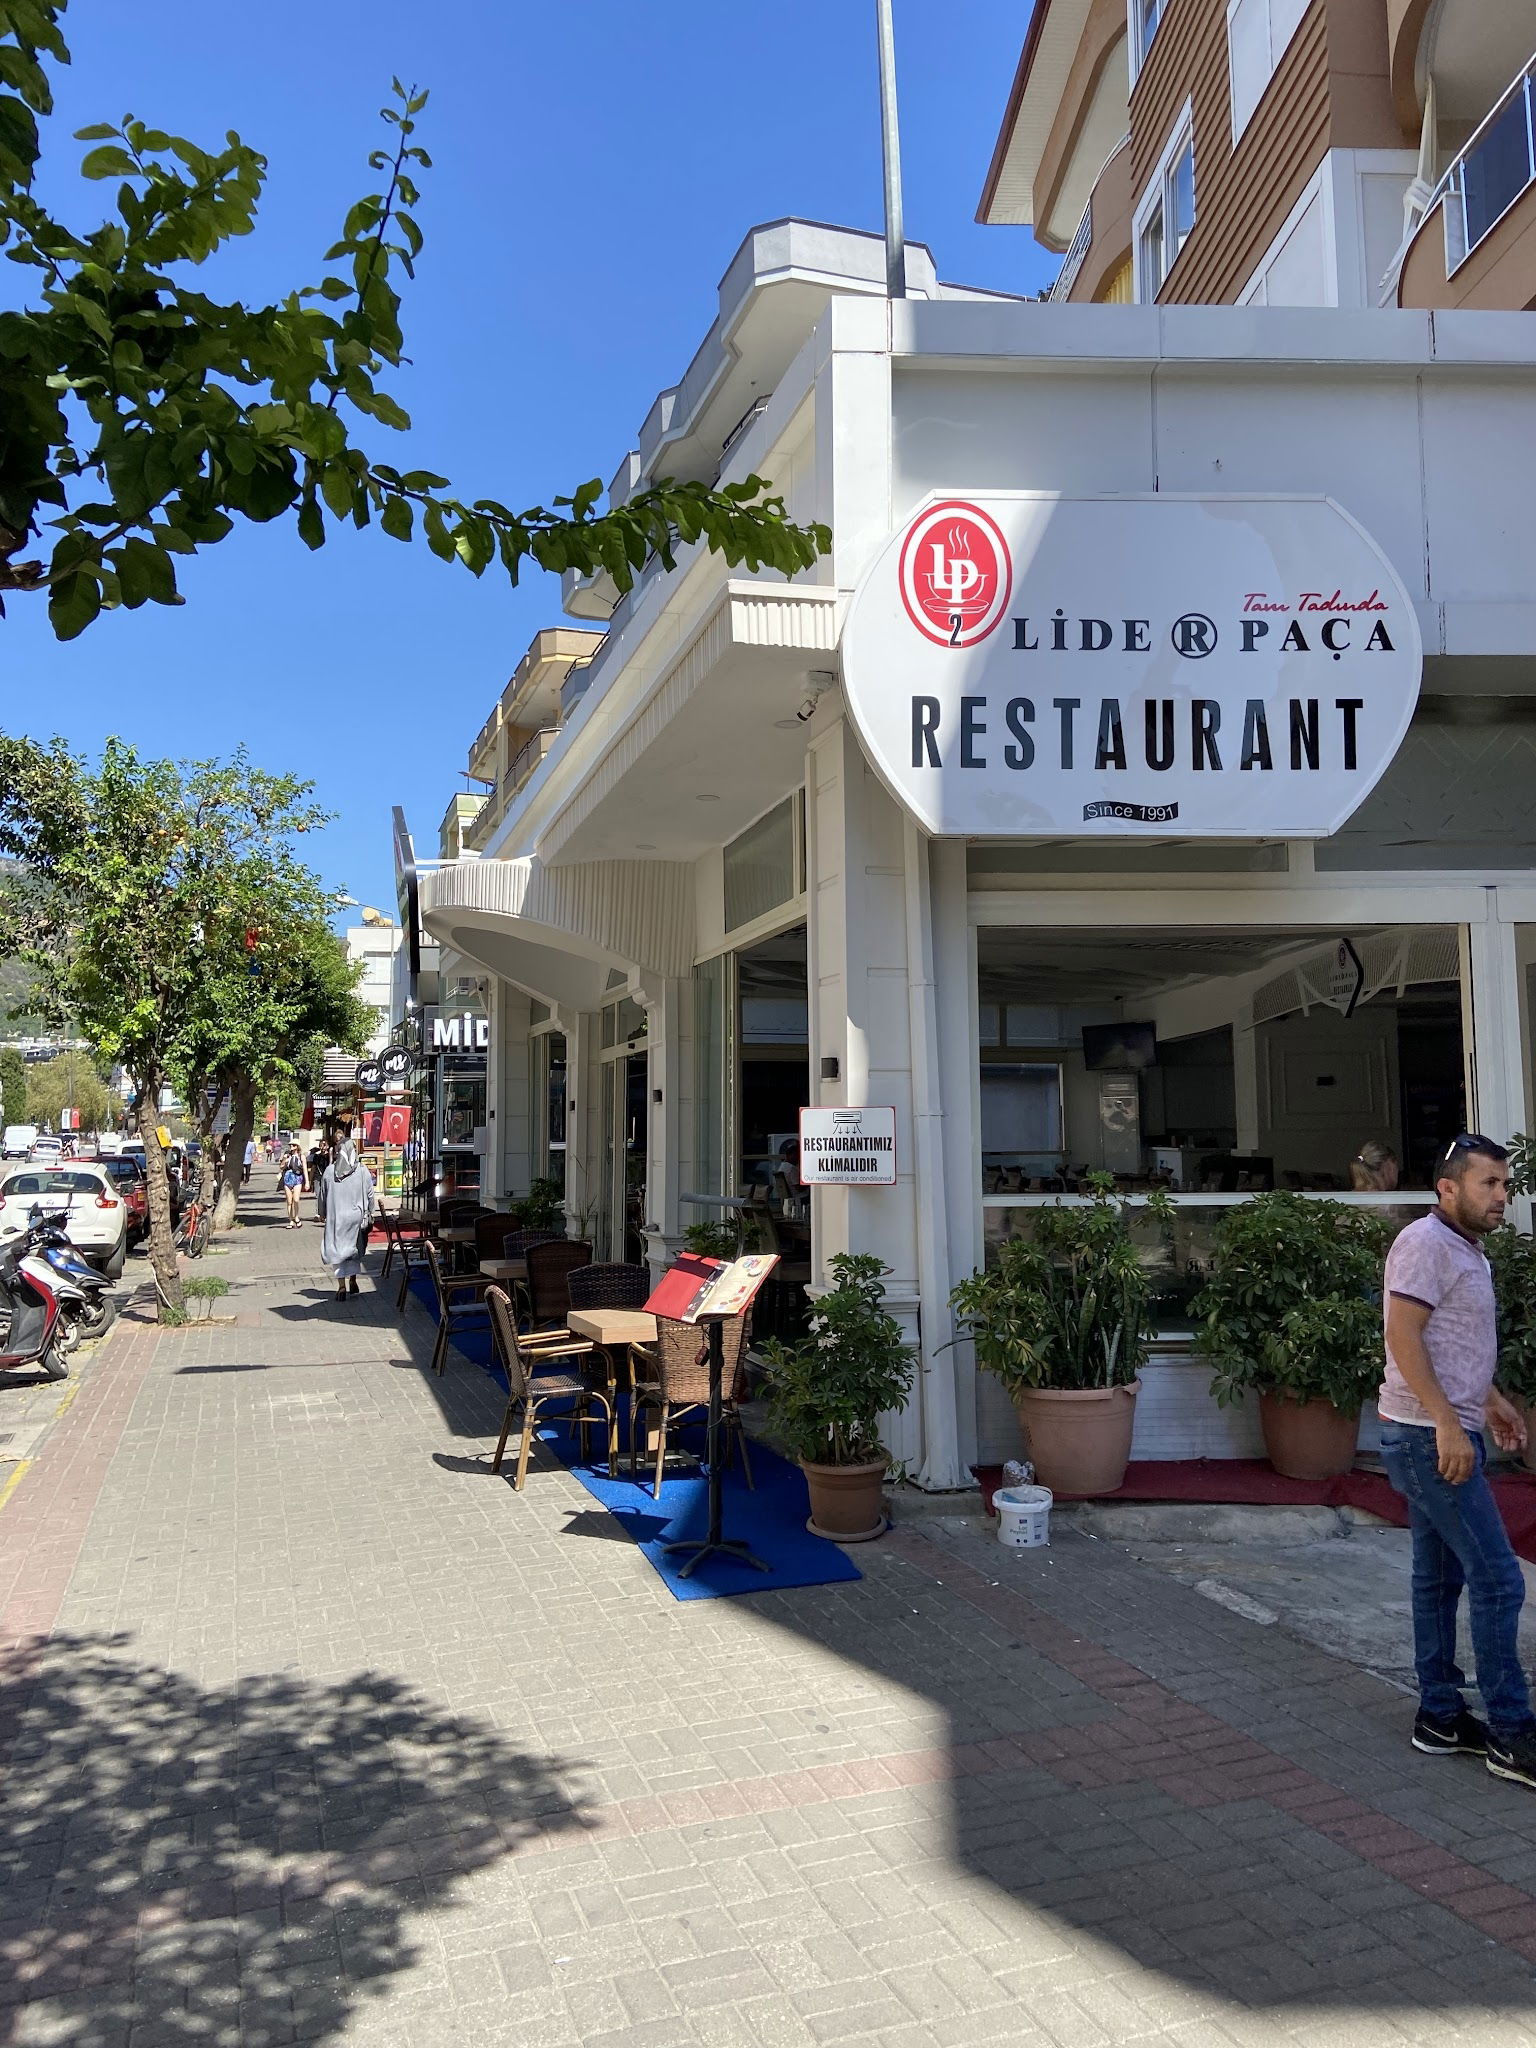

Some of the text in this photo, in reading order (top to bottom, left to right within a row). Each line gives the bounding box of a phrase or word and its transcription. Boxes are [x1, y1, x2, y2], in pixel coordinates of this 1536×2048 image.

[1243, 593, 1290, 612] Tam
[949, 613, 962, 647] 2
[1239, 618, 1396, 661] PAÇA
[911, 695, 1364, 772] RESTAURANT
[1086, 802, 1174, 821] Since 1991
[803, 1136, 893, 1152] RESTAURANTIMIZ
[818, 1155, 878, 1172] KLİMALIDIR
